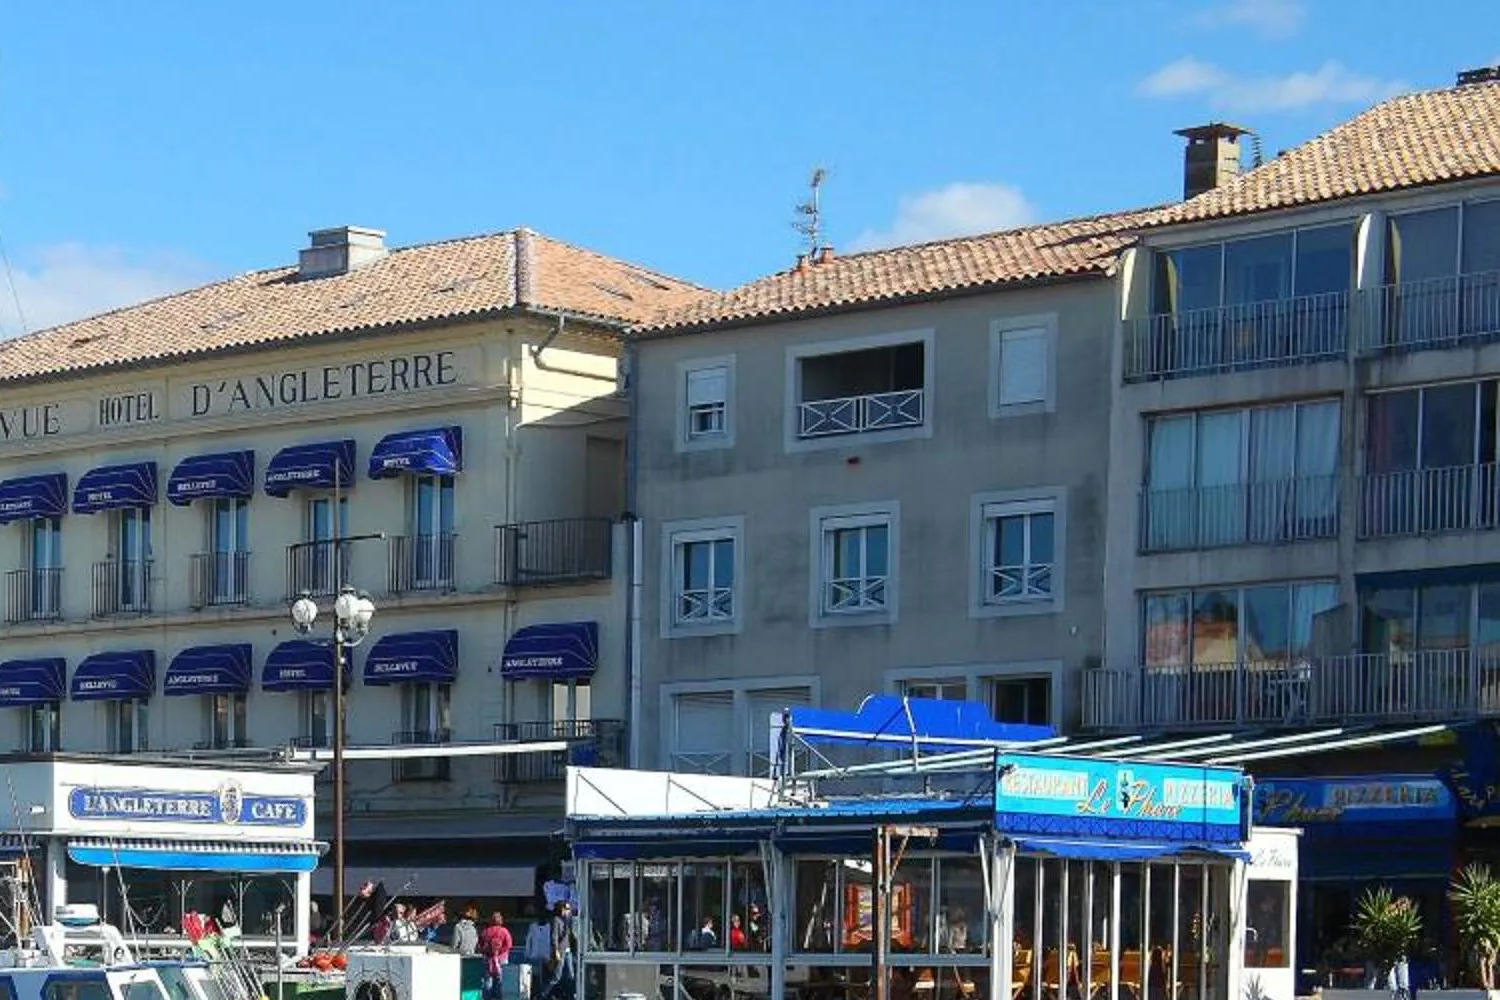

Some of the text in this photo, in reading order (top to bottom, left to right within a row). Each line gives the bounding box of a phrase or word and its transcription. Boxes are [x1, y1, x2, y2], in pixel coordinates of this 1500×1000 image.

[99, 392, 160, 425] HOTEL
[192, 352, 458, 417] D'ANGLETERRE
[83, 795, 213, 817] L'ANGLETERRE
